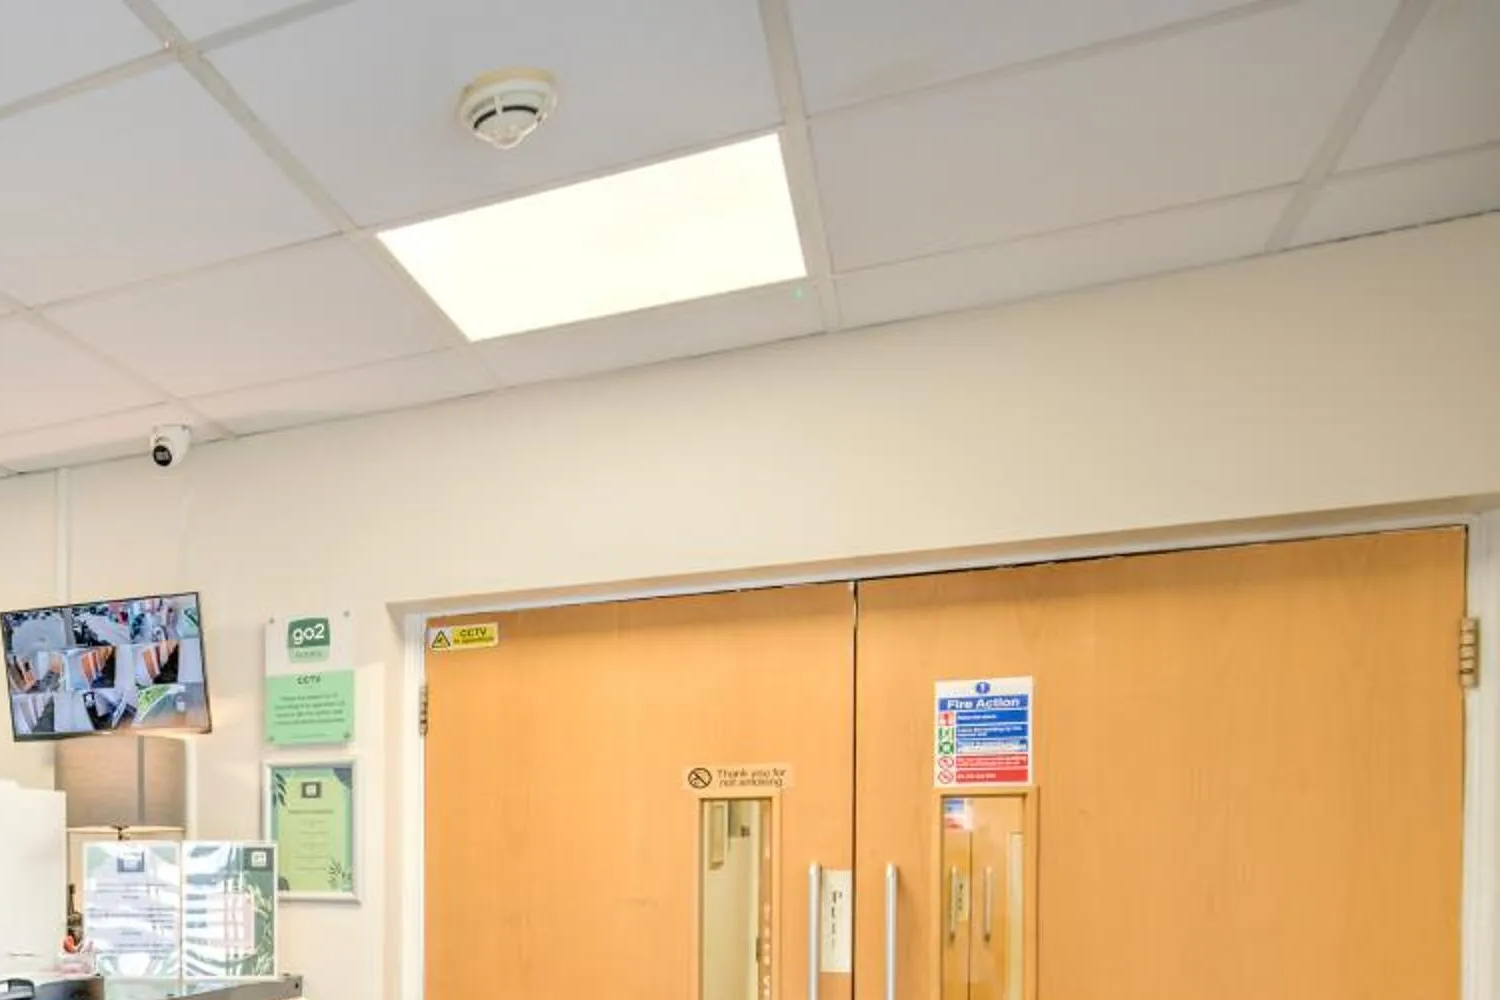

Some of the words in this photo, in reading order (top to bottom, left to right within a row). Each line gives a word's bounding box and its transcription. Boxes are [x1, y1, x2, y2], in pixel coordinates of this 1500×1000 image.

[292, 623, 325, 645] go2
[460, 627, 487, 637] CCTV
[947, 699, 973, 710] Fire
[975, 697, 1021, 709] Action
[717, 767, 749, 779] Thank
[773, 767, 787, 778] for
